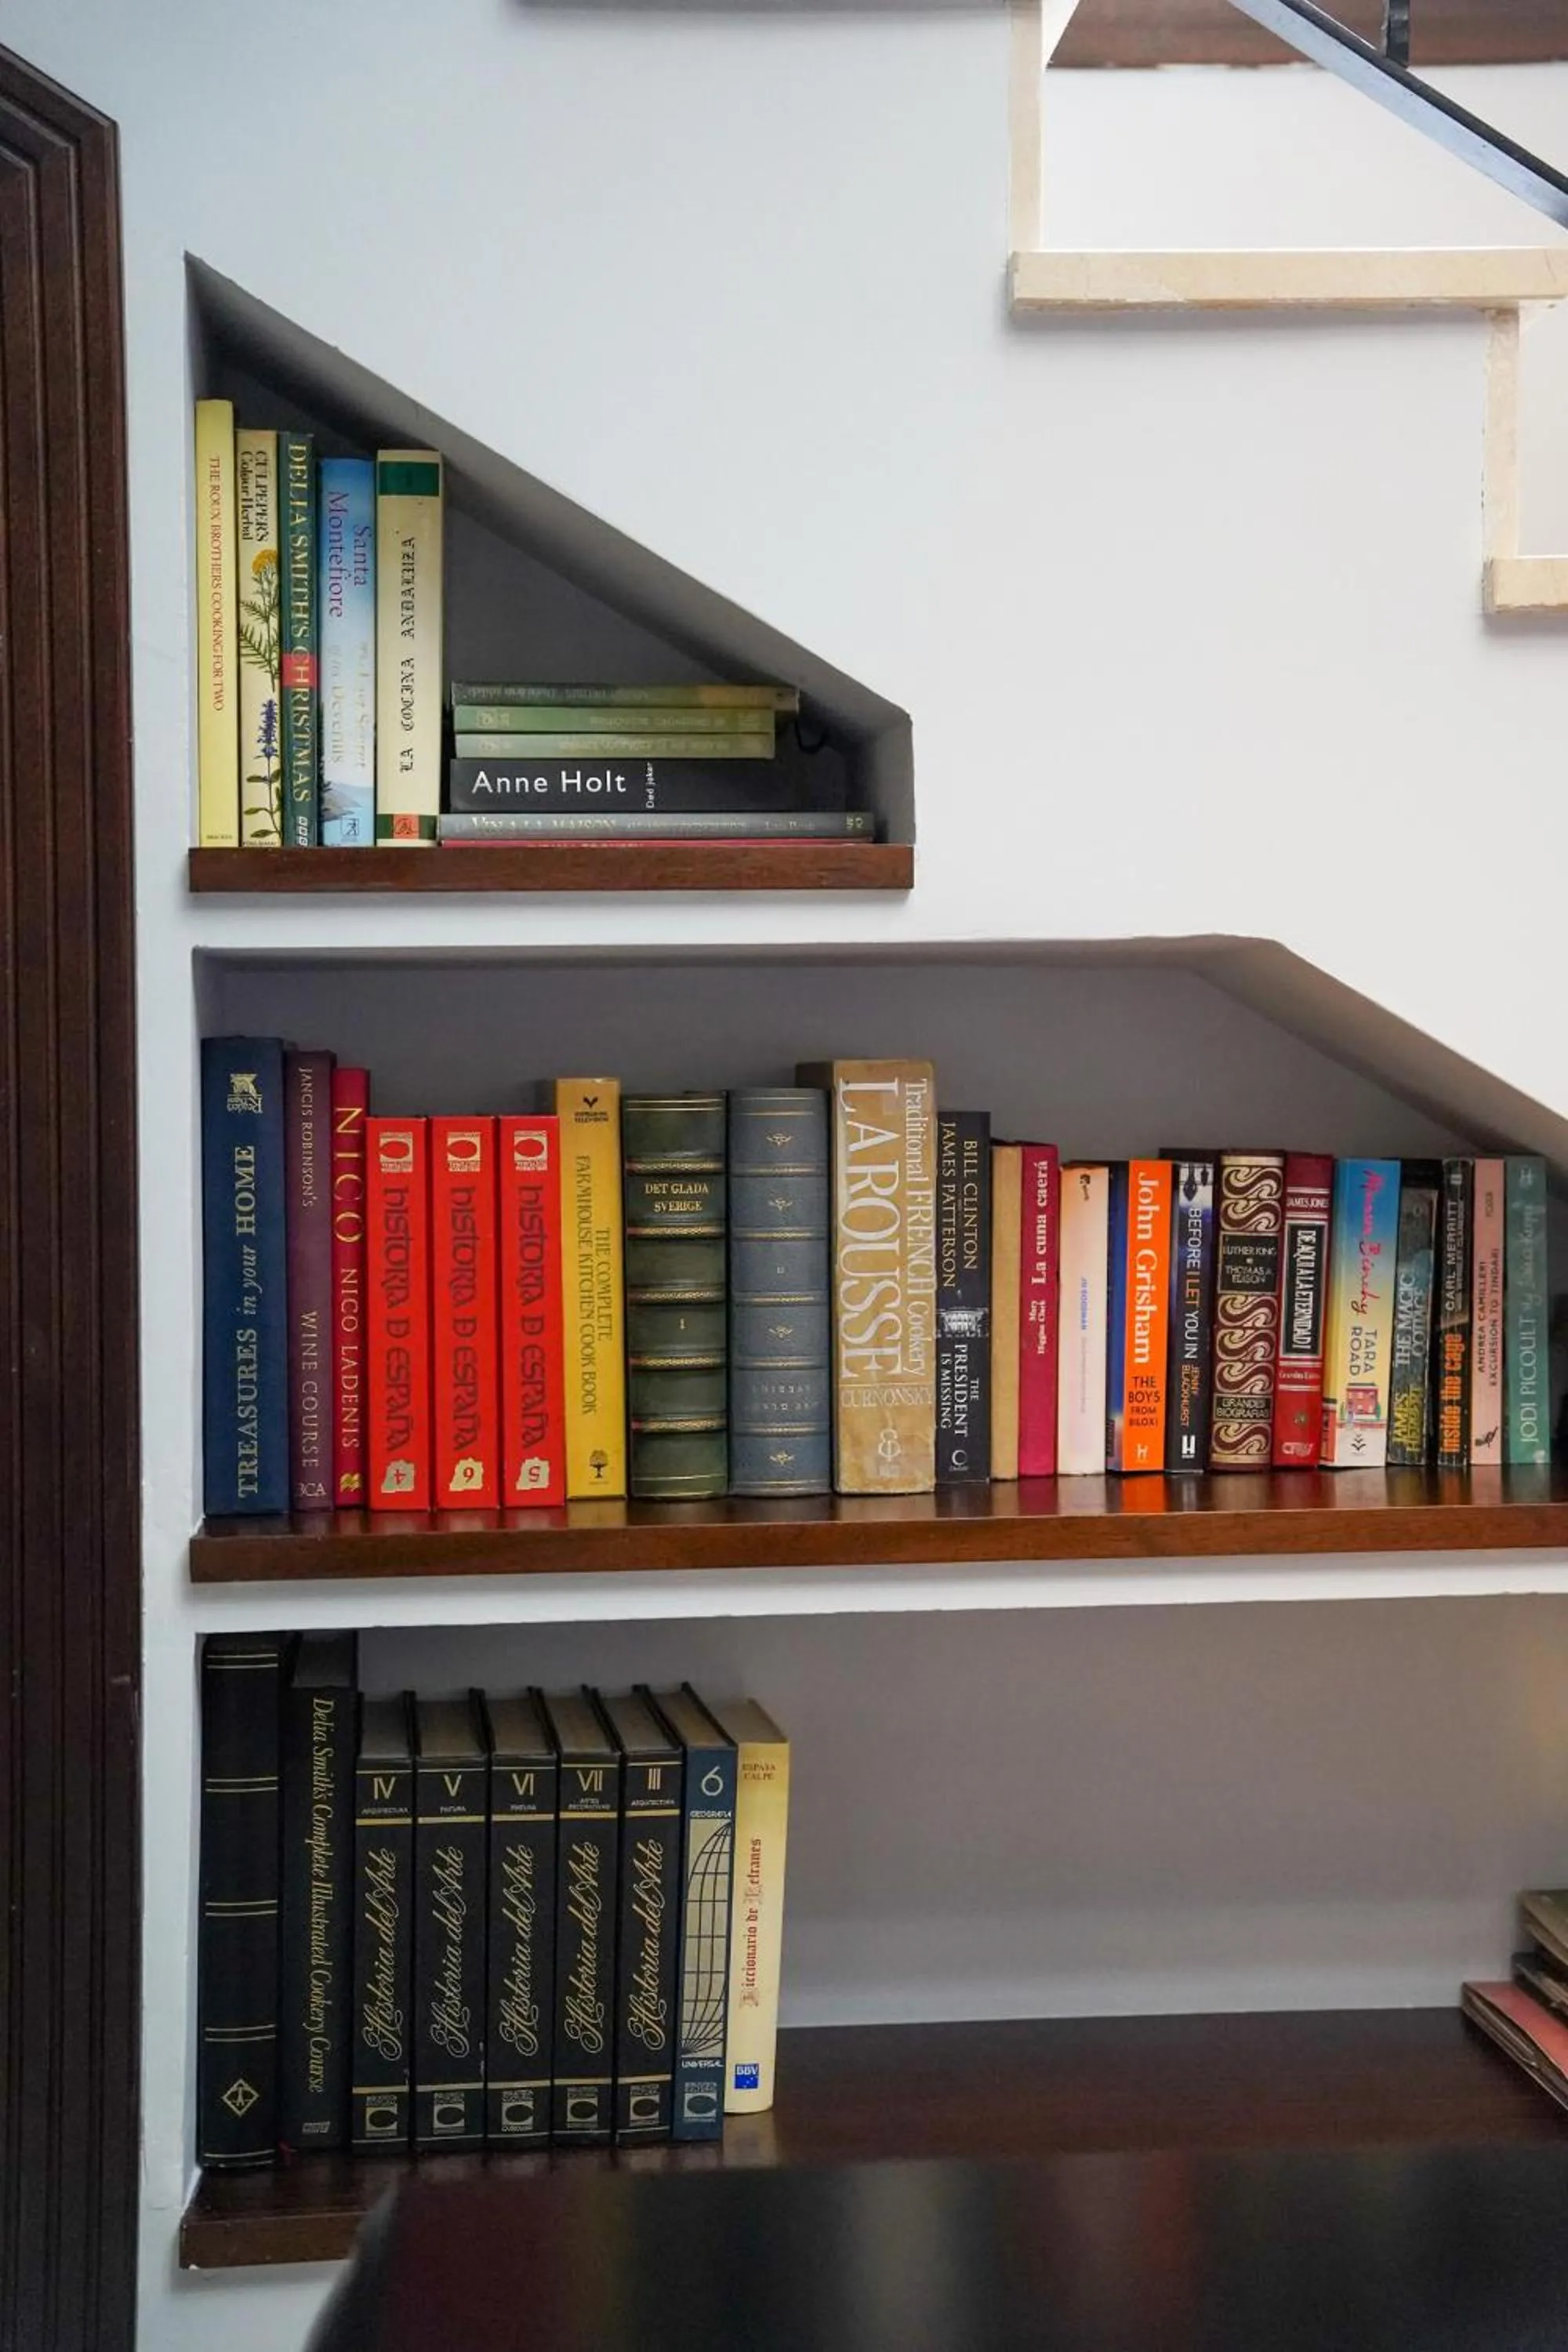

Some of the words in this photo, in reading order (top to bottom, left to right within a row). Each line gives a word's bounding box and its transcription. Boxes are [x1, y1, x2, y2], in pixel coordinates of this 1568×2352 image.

[209, 456, 221, 481] THE
[287, 442, 308, 527] DELIA
[209, 484, 222, 521] ROUX
[255, 449, 270, 543] CULPEPER'S
[210, 524, 223, 589] BROTHERS
[327, 491, 353, 619] Montefiore
[353, 524, 372, 586] Santa
[289, 535, 310, 638] SMITH'S
[211, 592, 223, 653] COOKING
[212, 655, 224, 679] FOR
[213, 682, 225, 711] TWO
[290, 645, 312, 802] CHRISTMAS
[399, 747, 415, 773] LA
[472, 770, 548, 793] Anne
[561, 769, 626, 793] Holt
[299, 1067, 313, 1116] JANCIS
[904, 1078, 929, 1182] Traditional
[941, 1121, 956, 1178] JAMES
[301, 1120, 318, 1208] ROBINSON'S
[334, 1107, 364, 1243] NICO
[963, 1140, 978, 1178] BILL
[1033, 1160, 1049, 1208] caerá
[235, 1145, 256, 1236] HOME
[575, 1155, 593, 1248] FARMHOUSE
[644, 1182, 669, 1195] DET
[670, 1182, 710, 1194] GLADA
[653, 1200, 703, 1213] SVERIGE
[1137, 1171, 1160, 1241] John
[1286, 1197, 1308, 1207] JAMES
[595, 1227, 612, 1258] THE
[838, 1078, 903, 1380] LAROUSSE
[906, 1189, 937, 1294] FRENCH
[941, 1183, 956, 1288] PATTERSON
[963, 1182, 978, 1270] CLINTON
[1035, 1214, 1047, 1254] cuna
[1186, 1207, 1202, 1269] BEFORE
[1446, 1199, 1458, 1265] MERRITT
[242, 1244, 263, 1294] your
[578, 1254, 596, 1320] KITCHEN
[1031, 1261, 1047, 1286] La
[1185, 1278, 1201, 1307] LET
[1225, 1266, 1265, 1276] THOMAS
[1350, 1241, 1381, 1316] Binchy
[1445, 1272, 1457, 1311] CARL
[1478, 1261, 1487, 1321] CAMILLERI
[1490, 1247, 1501, 1294] TINDARI
[236, 1295, 256, 1316] in
[340, 1269, 358, 1333] NICO
[595, 1261, 613, 1341] COMPLETE
[1134, 1248, 1159, 1364] Grisham
[1184, 1310, 1199, 1340] YOU
[1397, 1272, 1416, 1330] MAGIC
[1490, 1299, 1499, 1314] TO
[300, 1310, 318, 1371] WINE
[579, 1323, 597, 1368] COOK
[902, 1300, 933, 1377] Cookery
[941, 1352, 951, 1366] IS
[1183, 1342, 1198, 1359] IN
[1348, 1326, 1363, 1377] ROAD
[1363, 1329, 1377, 1374] TARA
[1394, 1333, 1412, 1367] THE
[1443, 1333, 1465, 1370] cage
[1477, 1325, 1486, 1373] ANDREA
[1490, 1318, 1498, 1387] EXCURSION
[1519, 1316, 1537, 1396] PICOULT
[341, 1345, 360, 1449] LADENIS
[580, 1371, 597, 1414] BOOK
[840, 1386, 933, 1407] CURNONSKY
[940, 1367, 953, 1429] MISSING
[954, 1344, 968, 1436] PRESIDENT
[970, 1377, 979, 1401] THE
[1127, 1390, 1160, 1403] BOYS
[1131, 1376, 1156, 1388] THE
[1180, 1364, 1191, 1427] BLACKHURST
[1440, 1375, 1462, 1400] the
[237, 1327, 259, 1498] TREASURES
[302, 1381, 319, 1468] COURSE
[1131, 1406, 1156, 1415] FROM
[1392, 1392, 1410, 1443] JAMES
[1519, 1403, 1538, 1443] JODI
[313, 1698, 336, 1742] Delia
[313, 1746, 336, 1800] Smith's
[372, 1776, 396, 1800] IV
[443, 1774, 462, 1797] V
[512, 1773, 535, 1796] VI
[576, 1769, 603, 1791] VII
[648, 1768, 662, 1790] III
[701, 1766, 724, 1797] 6
[305, 1803, 335, 1878] Complete
[568, 1841, 601, 1889] Arte
[632, 1838, 664, 1886] Arte
[365, 1847, 397, 1898] Arte
[433, 1846, 464, 1896] Arte
[502, 1843, 534, 1891] Arte
[311, 1881, 334, 1966] Illustrated
[365, 1892, 399, 1944] del
[433, 1889, 467, 1943] del
[502, 1888, 537, 1940] del
[568, 1886, 602, 1940] del
[632, 1884, 666, 1936] del
[746, 1907, 759, 1922] de
[302, 1970, 333, 2033] Cookery
[362, 1947, 404, 2060] Historia
[430, 1944, 470, 2058] Historia
[499, 1942, 539, 2056] Historia
[564, 1940, 604, 2054] Historia
[628, 1936, 666, 2051] Historia
[309, 2037, 331, 2093] Course
[735, 2066, 760, 2075] BBV
